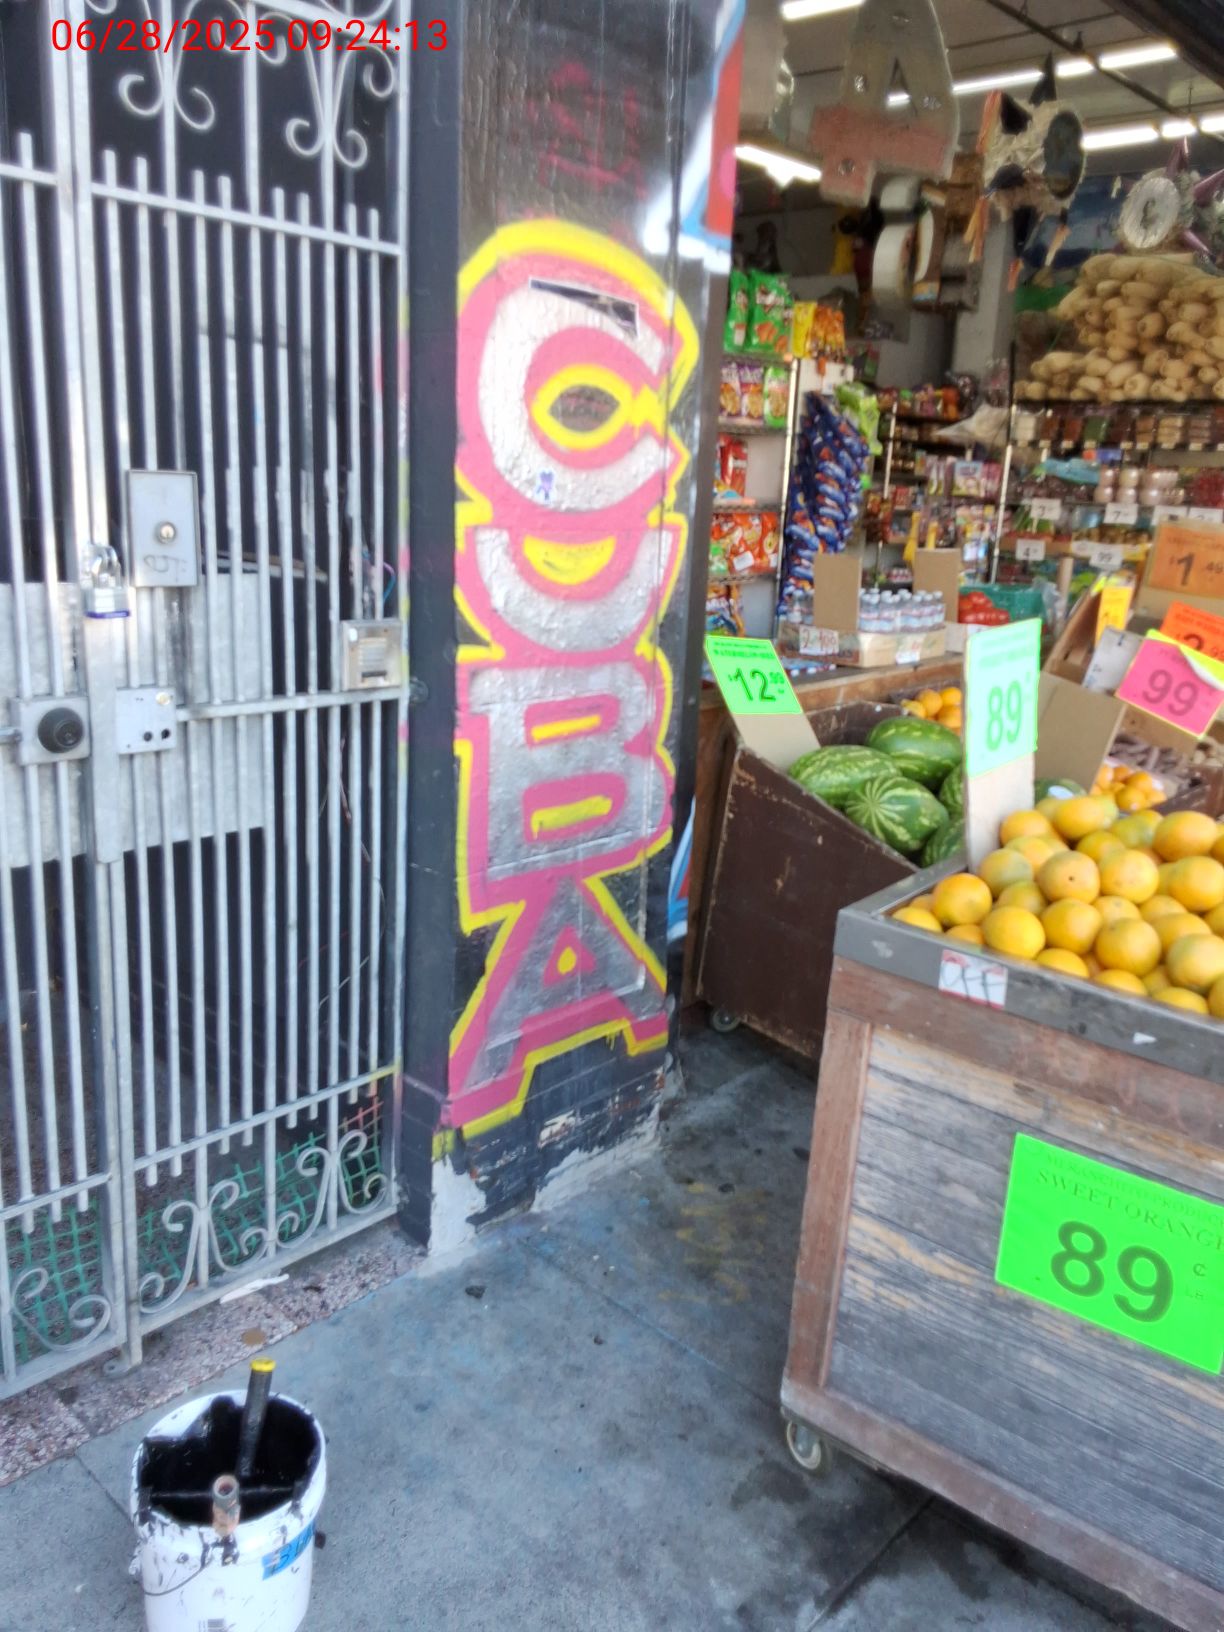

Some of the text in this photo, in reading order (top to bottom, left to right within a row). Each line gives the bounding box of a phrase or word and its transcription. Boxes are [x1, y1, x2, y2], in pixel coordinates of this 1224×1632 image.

[456, 235, 690, 1130] CUBA
[986, 679, 1023, 752] 89
[1142, 668, 1200, 718] 99
[1036, 1167, 1119, 1210] SWEET
[1050, 1220, 1174, 1323] 89
